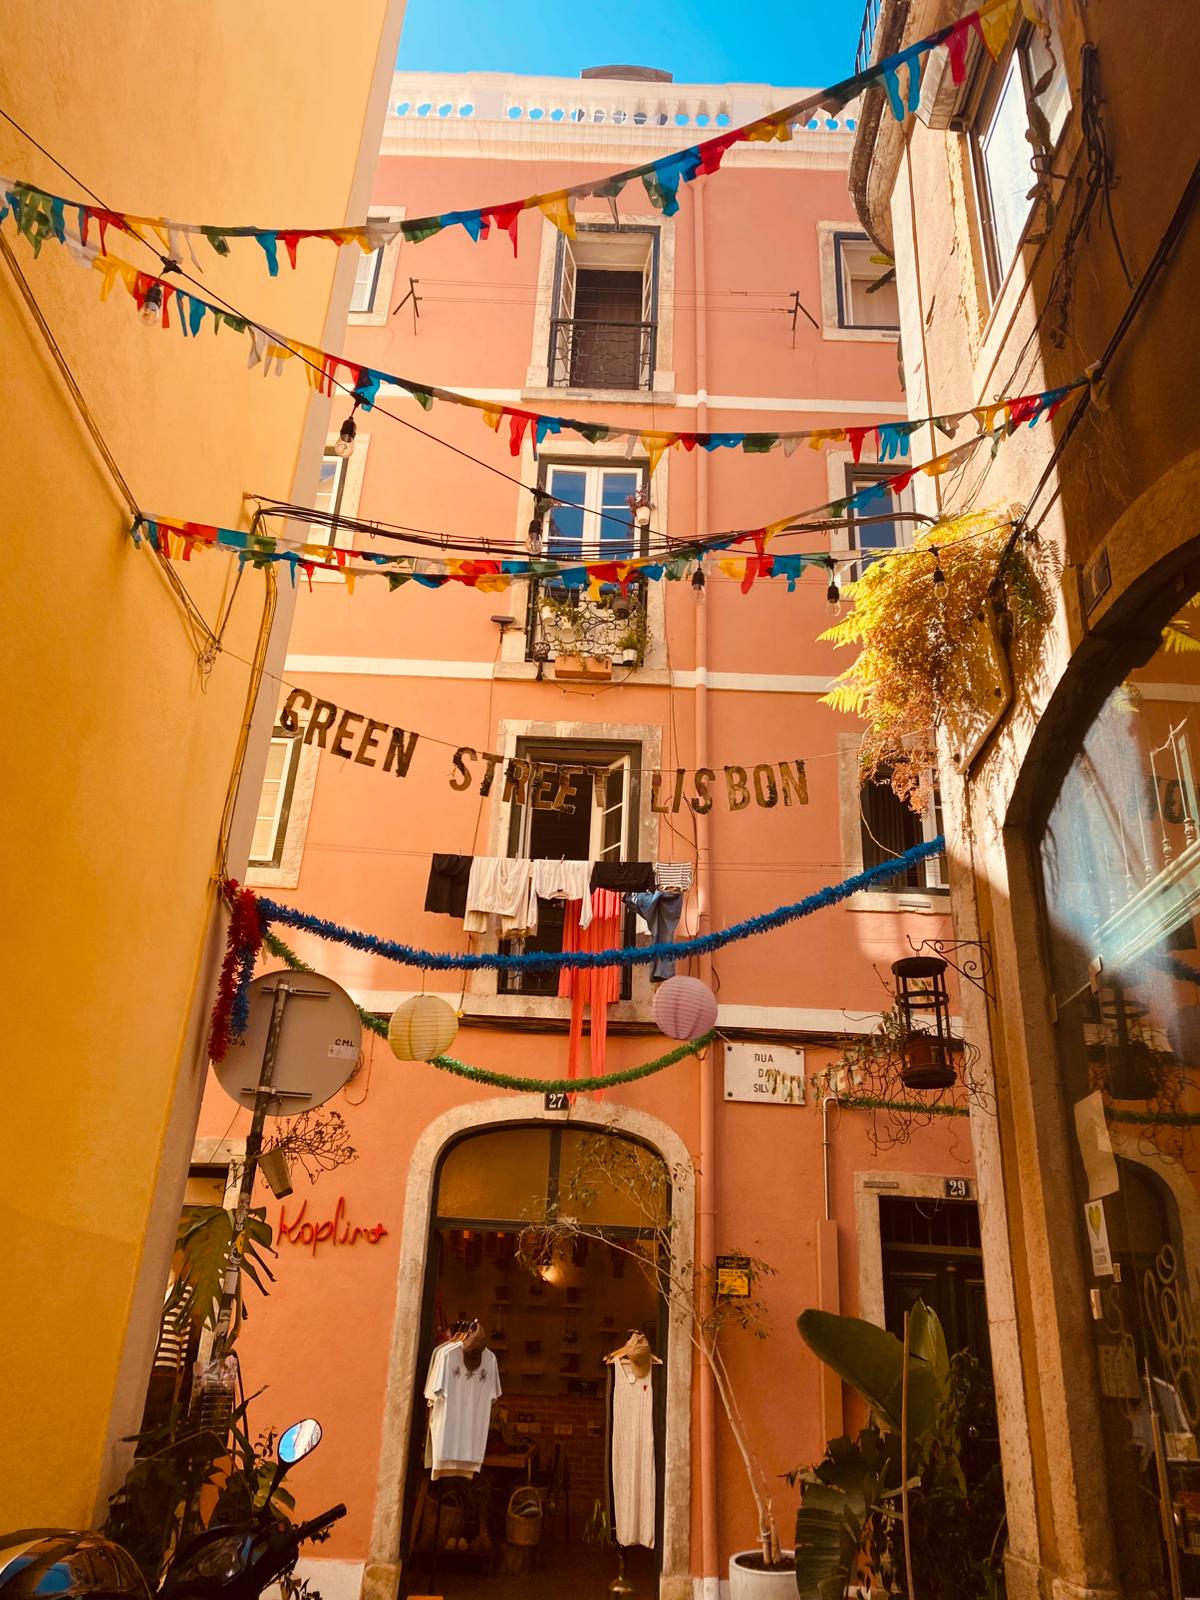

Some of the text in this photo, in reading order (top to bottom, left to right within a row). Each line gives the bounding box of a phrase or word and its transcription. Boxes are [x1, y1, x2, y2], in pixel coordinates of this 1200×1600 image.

[280, 688, 809, 815] GREEN STREET LISBON
[754, 1053, 774, 1063] RUA
[549, 1093, 564, 1108] 27
[949, 1180, 966, 1196] 29
